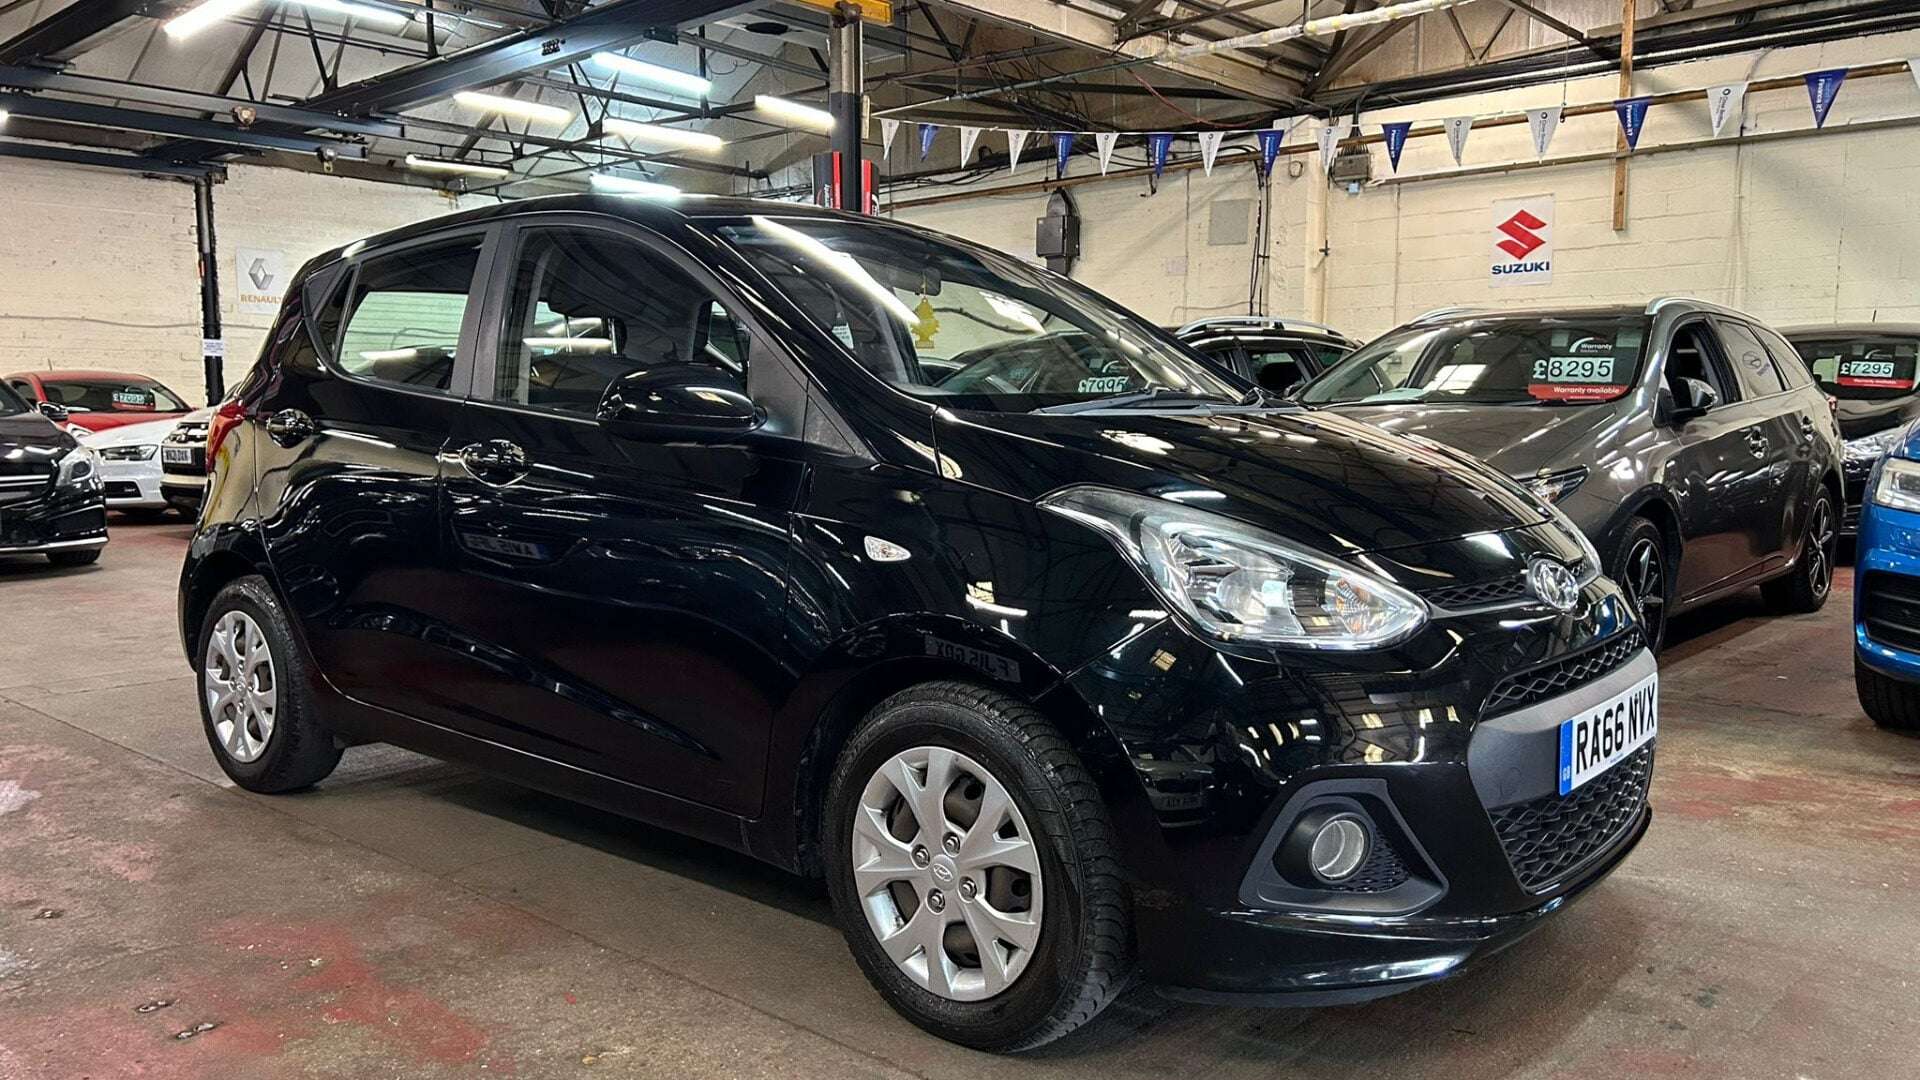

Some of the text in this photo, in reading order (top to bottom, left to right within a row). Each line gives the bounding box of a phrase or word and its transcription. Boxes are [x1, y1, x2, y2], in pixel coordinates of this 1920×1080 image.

[1491, 261, 1550, 275] SUZUKI
[1581, 343, 1613, 351] Warranty
[1532, 359, 1611, 379] £8295
[1840, 362, 1892, 375] £7295
[1576, 682, 1656, 774] RA66 NVX
